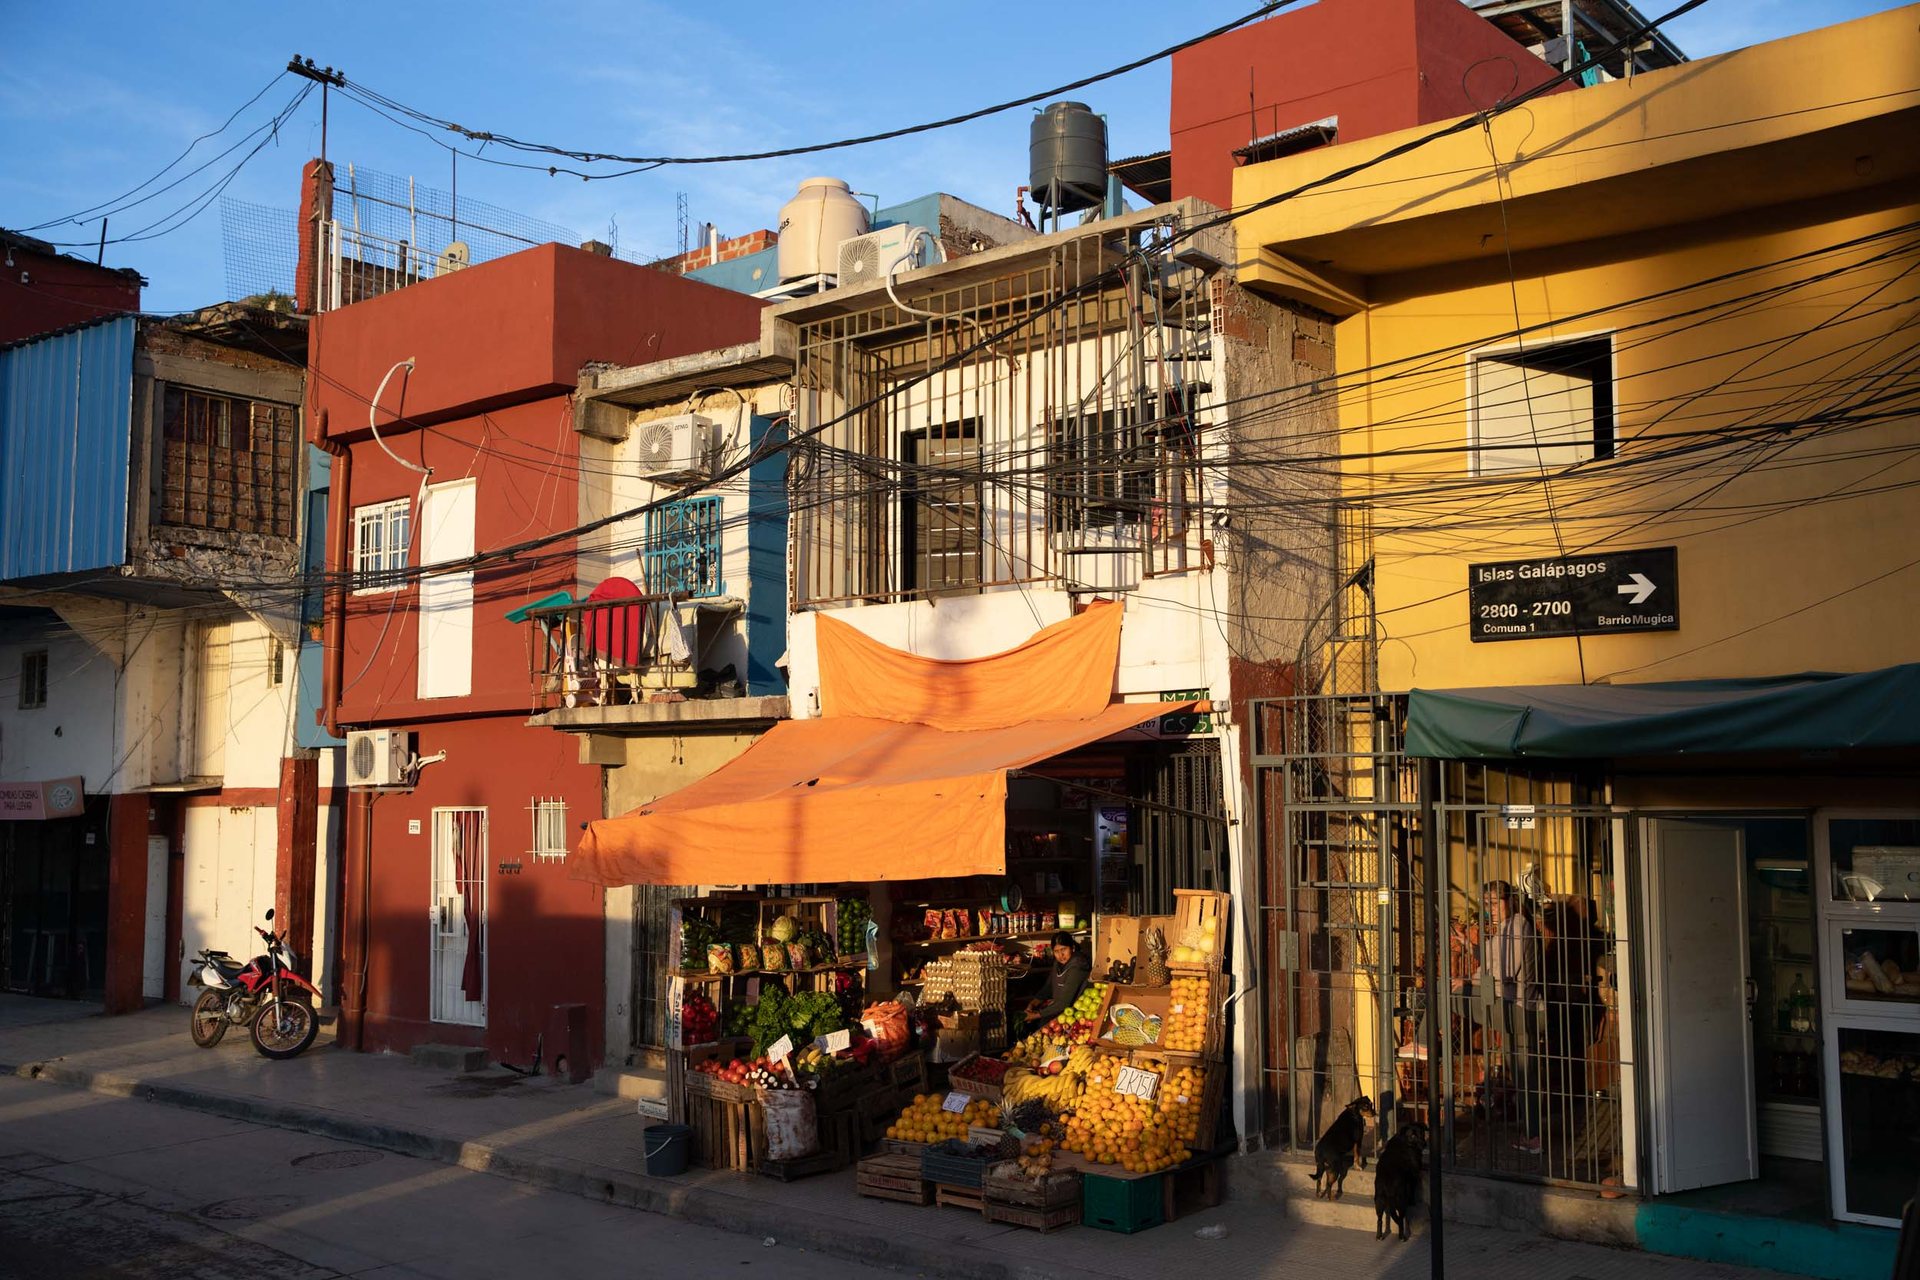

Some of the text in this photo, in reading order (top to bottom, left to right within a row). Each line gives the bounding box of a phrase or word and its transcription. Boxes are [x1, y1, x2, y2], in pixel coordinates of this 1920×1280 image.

[1479, 561, 1607, 582] Islas Galápagos
[1481, 604, 1518, 619] 2800
[1532, 601, 1571, 617] 2700
[1598, 613, 1674, 626] Barrio Mugica
[1483, 623, 1535, 634] Comuna 1
